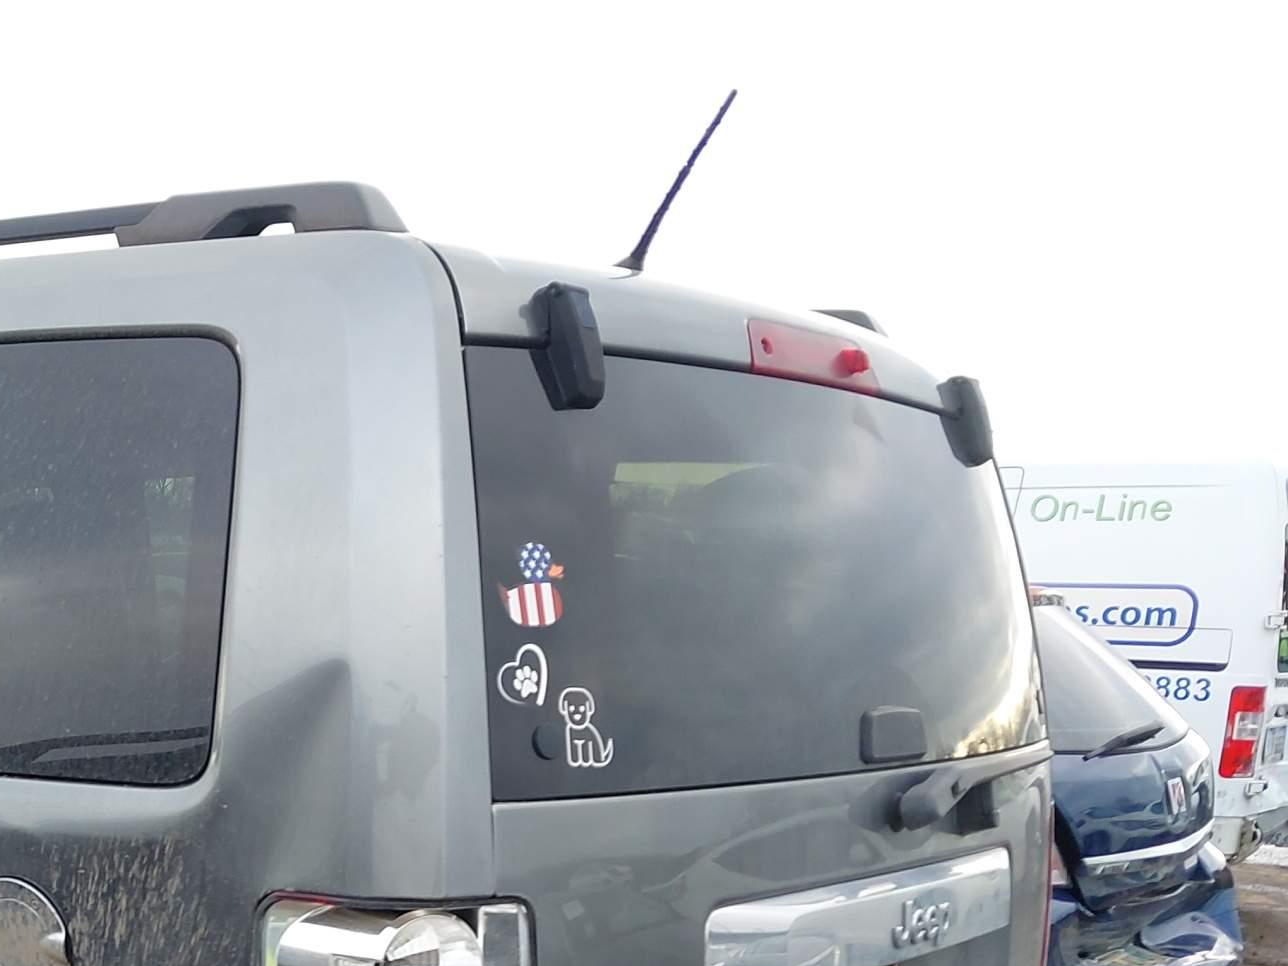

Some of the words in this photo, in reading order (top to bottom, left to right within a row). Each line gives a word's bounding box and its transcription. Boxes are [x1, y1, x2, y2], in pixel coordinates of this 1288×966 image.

[1030, 494, 1173, 522] On-Line
[1066, 605, 1177, 627] s.com
[1145, 676, 1212, 702] 883
